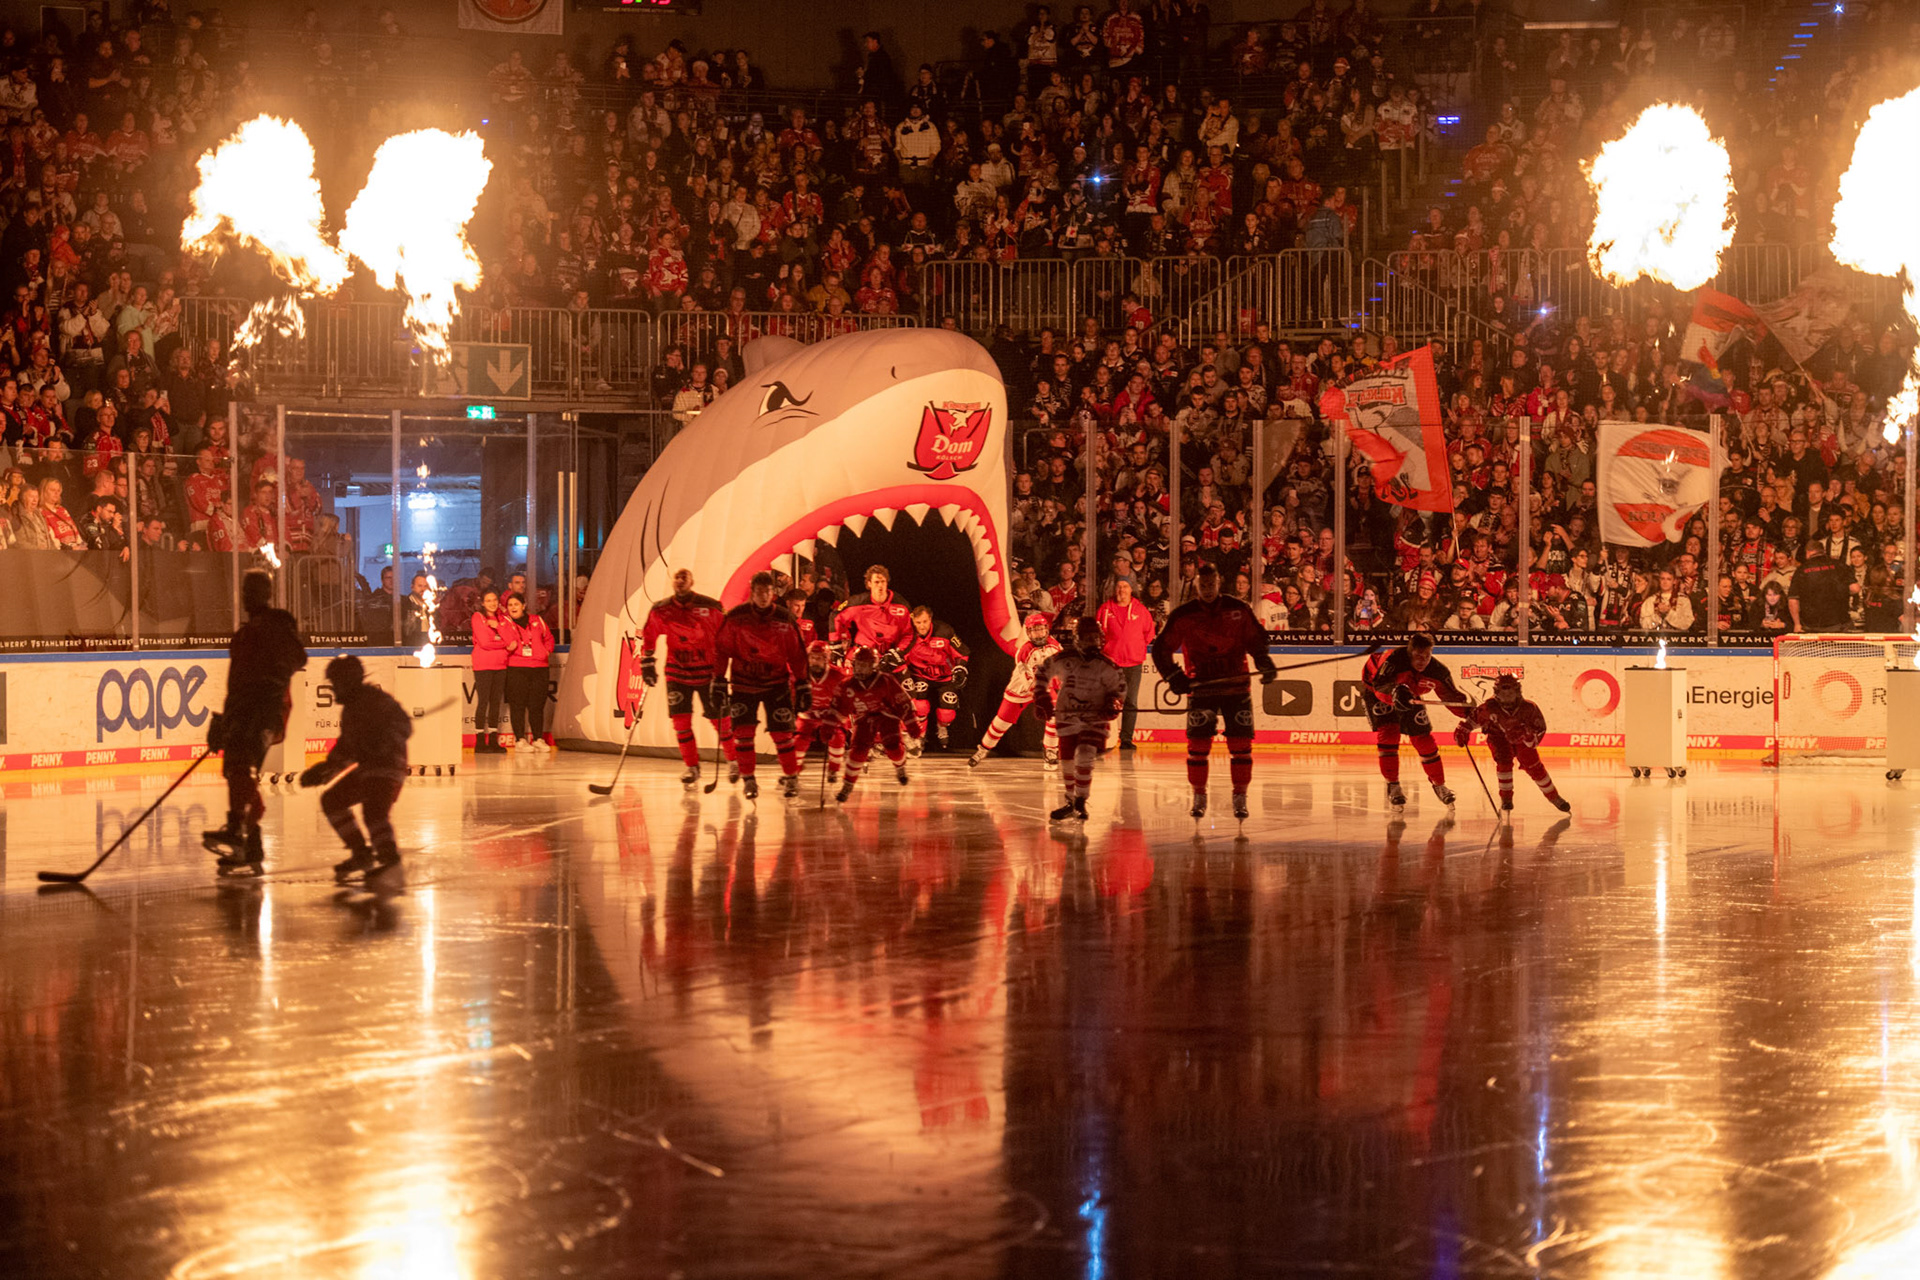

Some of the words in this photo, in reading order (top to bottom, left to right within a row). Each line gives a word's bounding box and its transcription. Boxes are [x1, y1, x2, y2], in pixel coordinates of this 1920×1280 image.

[931, 434, 974, 454] Dom
[1462, 665, 1499, 679] KÖLNER
[96, 665, 209, 743] pape
